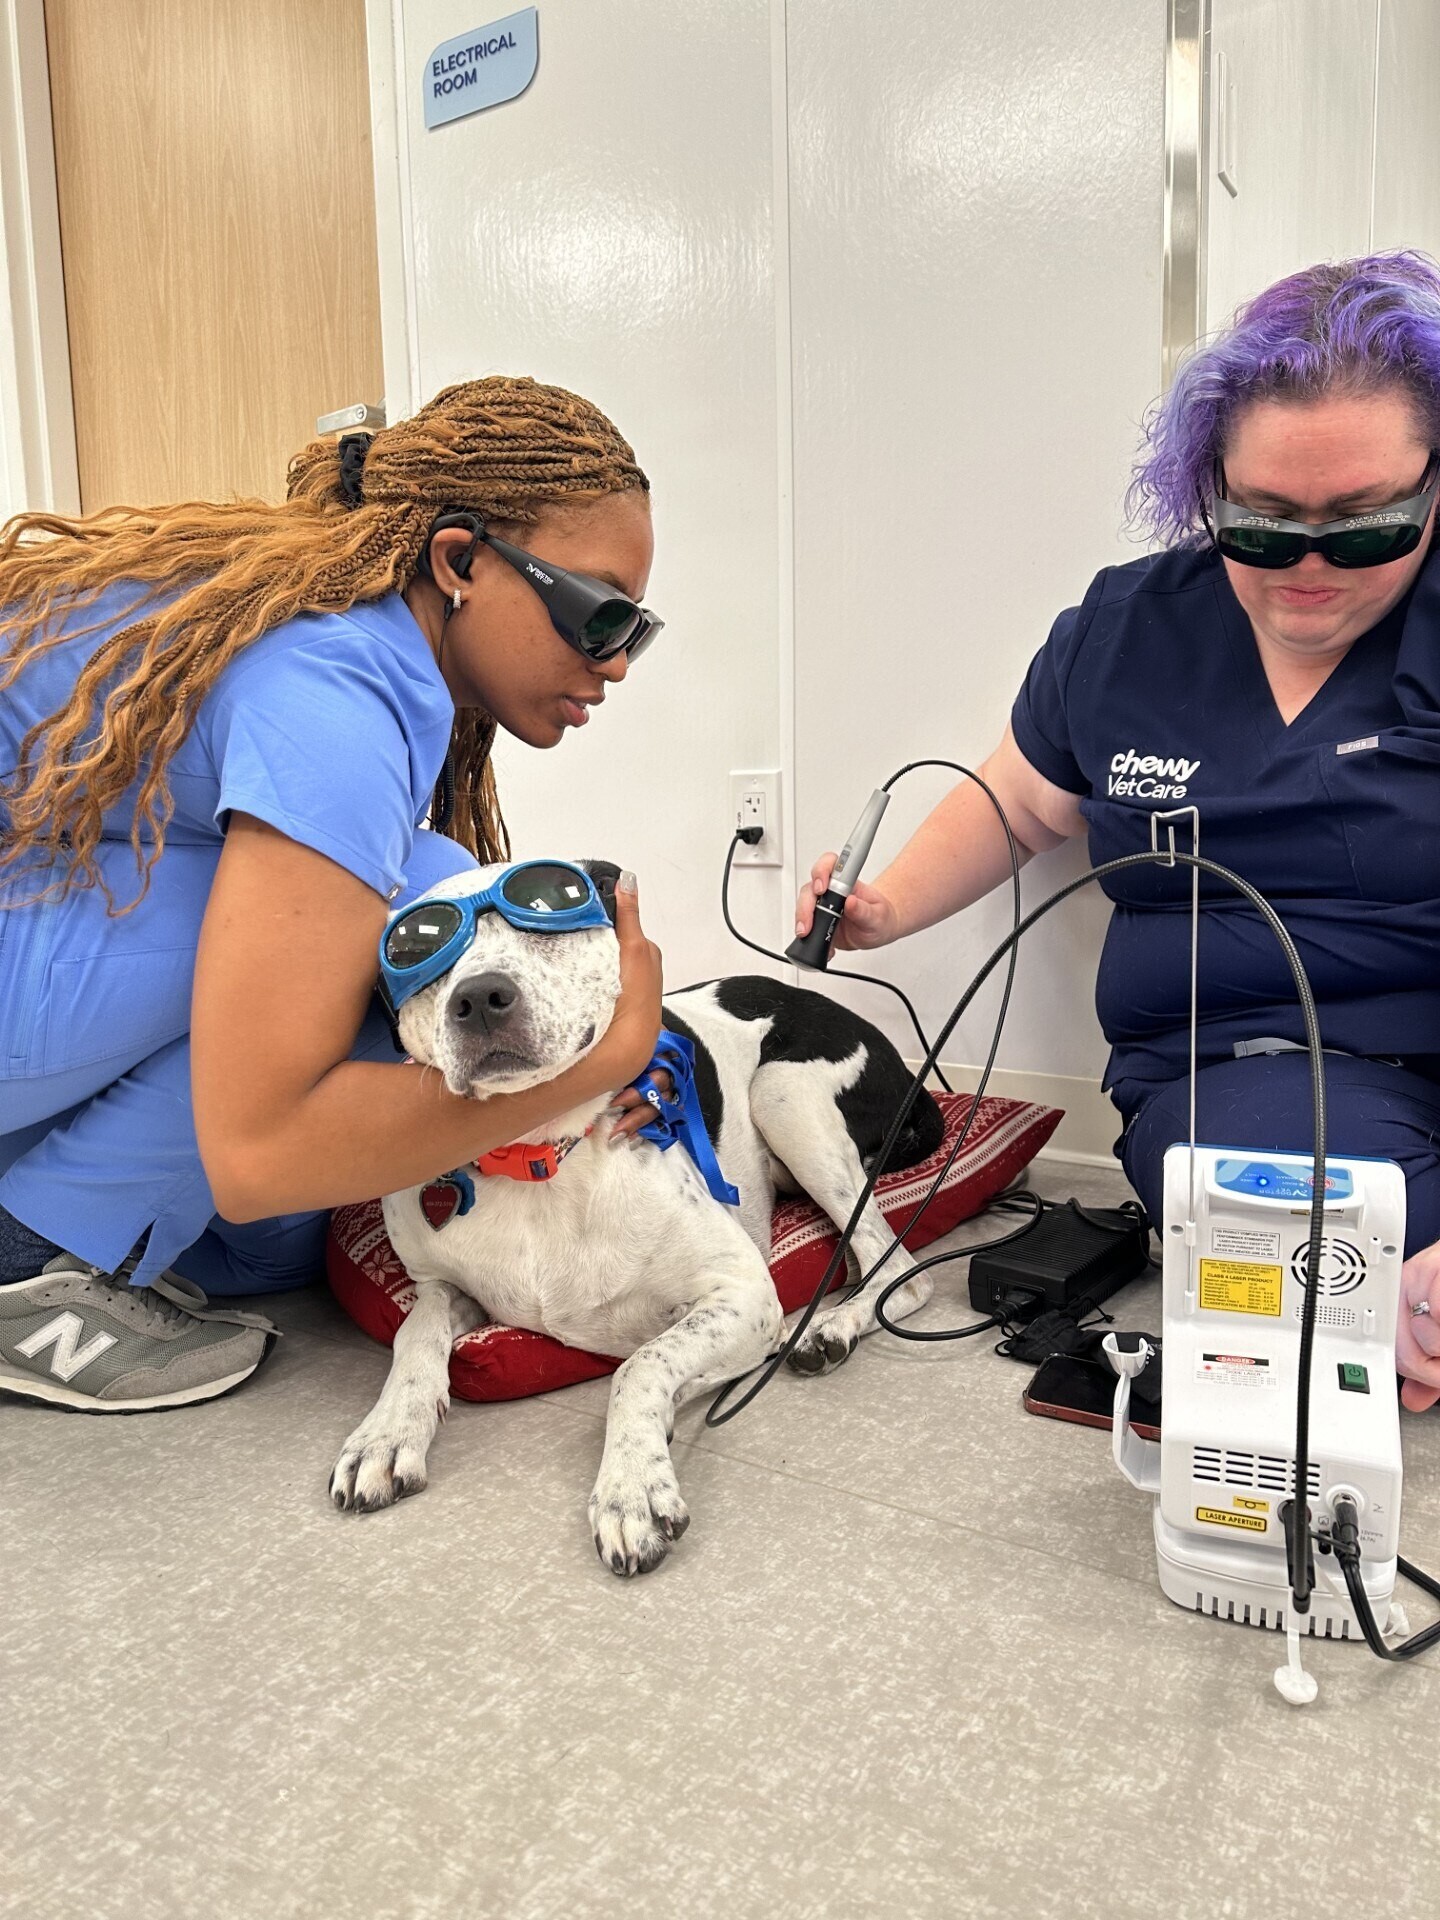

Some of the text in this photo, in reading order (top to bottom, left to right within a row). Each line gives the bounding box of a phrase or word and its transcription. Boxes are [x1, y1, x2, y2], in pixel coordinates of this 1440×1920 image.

[432, 32, 516, 77] ELECTRICAL
[433, 67, 477, 98] ROOM
[1111, 749, 1200, 782] chewy
[1108, 775, 1187, 799] VetCare
[14, 1310, 119, 1383] N
[1205, 1511, 1262, 1528] LASER APERTURE
